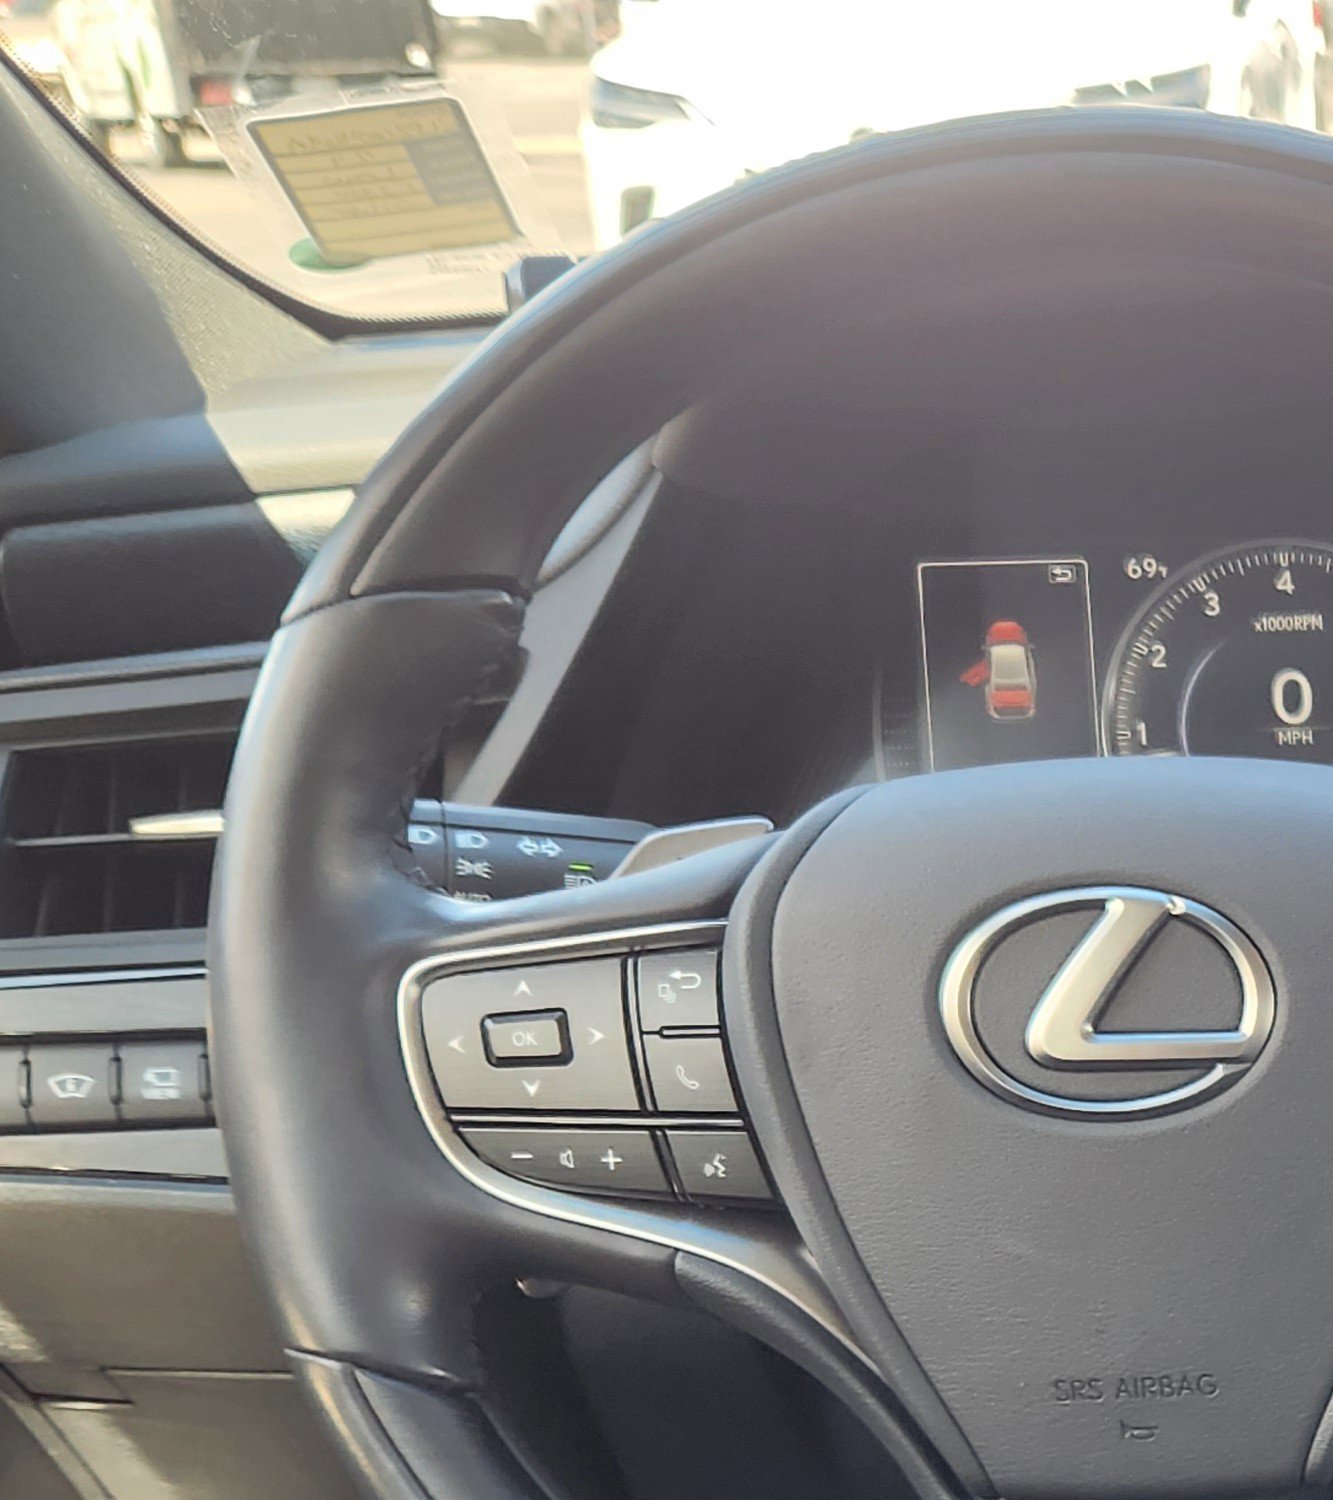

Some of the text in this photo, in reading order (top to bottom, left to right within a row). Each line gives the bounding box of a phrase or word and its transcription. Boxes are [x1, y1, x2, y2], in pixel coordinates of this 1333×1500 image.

[1275, 569, 1296, 595] 4
[1204, 591, 1220, 616] 3
[1151, 643, 1168, 668] 2
[1271, 669, 1313, 726] 0
[1136, 720, 1148, 746] 1
[1276, 729, 1314, 746] MPH
[511, 1028, 539, 1047] OK
[1053, 1373, 1220, 1403] SRS AIRBAG
